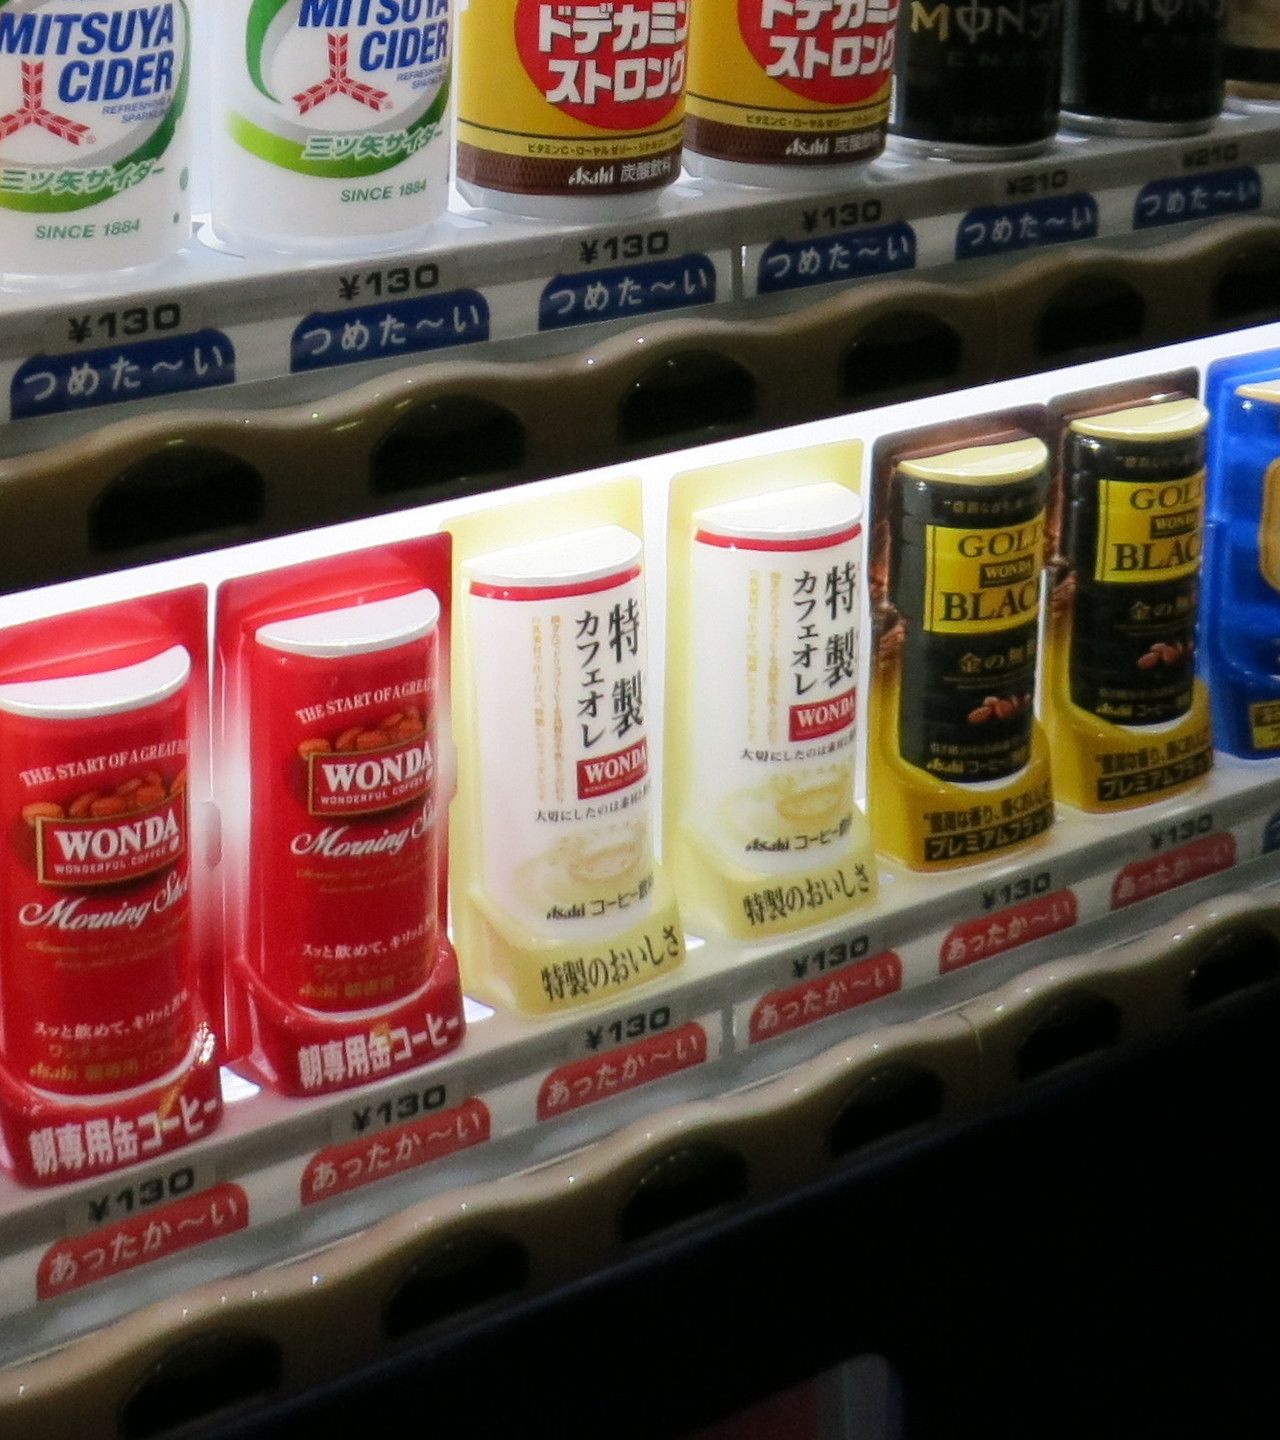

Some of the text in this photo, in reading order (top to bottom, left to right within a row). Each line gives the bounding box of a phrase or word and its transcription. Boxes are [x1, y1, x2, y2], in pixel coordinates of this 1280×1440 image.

[359, 18, 449, 72] CIDER
[57, 50, 175, 104] CIDER
[301, 122, 443, 160] 三ツ矢サイダー
[785, 137, 829, 156] Asahi
[340, 179, 427, 202] SINCE 1884
[568, 165, 615, 185] Asahi
[35, 218, 141, 240] SINCE 1884
[802, 199, 881, 232] ¥130
[580, 231, 669, 264] ¥130
[338, 264, 440, 301] ¥130
[68, 303, 181, 344] ¥130
[792, 570, 819, 695] カフェオレ
[825, 561, 856, 688] 特製
[576, 610, 606, 748] カフェオレ
[608, 598, 644, 739] 特製
[295, 687, 401, 725] THE START OF A
[20, 767, 55, 788] THE
[56, 756, 106, 780] START
[109, 752, 129, 768] OF
[130, 751, 139, 764] A
[321, 740, 432, 793] WONDA
[321, 790, 387, 805] WONDERFUL
[54, 808, 180, 861] WONDA
[290, 824, 410, 858] Morning
[54, 846, 167, 875] WONDERFUL COFFEE
[743, 863, 869, 926] 特製のおいしさ
[982, 872, 1051, 909] ¥130
[19, 896, 153, 931] Morning
[541, 925, 679, 1002] 特製のおいしさ
[792, 936, 869, 978] ¥130
[585, 1006, 670, 1050] ¥130
[298, 1012, 459, 1089] 朝専用缶コーヒー
[546, 1034, 698, 1108] あったか〜い
[351, 1084, 446, 1132] ¥130
[28, 1094, 219, 1178] 朝専用缶コーヒー
[311, 1109, 481, 1191] あったか〜い
[87, 1167, 194, 1222] ¥130
[48, 1195, 238, 1284] あったか〜い
